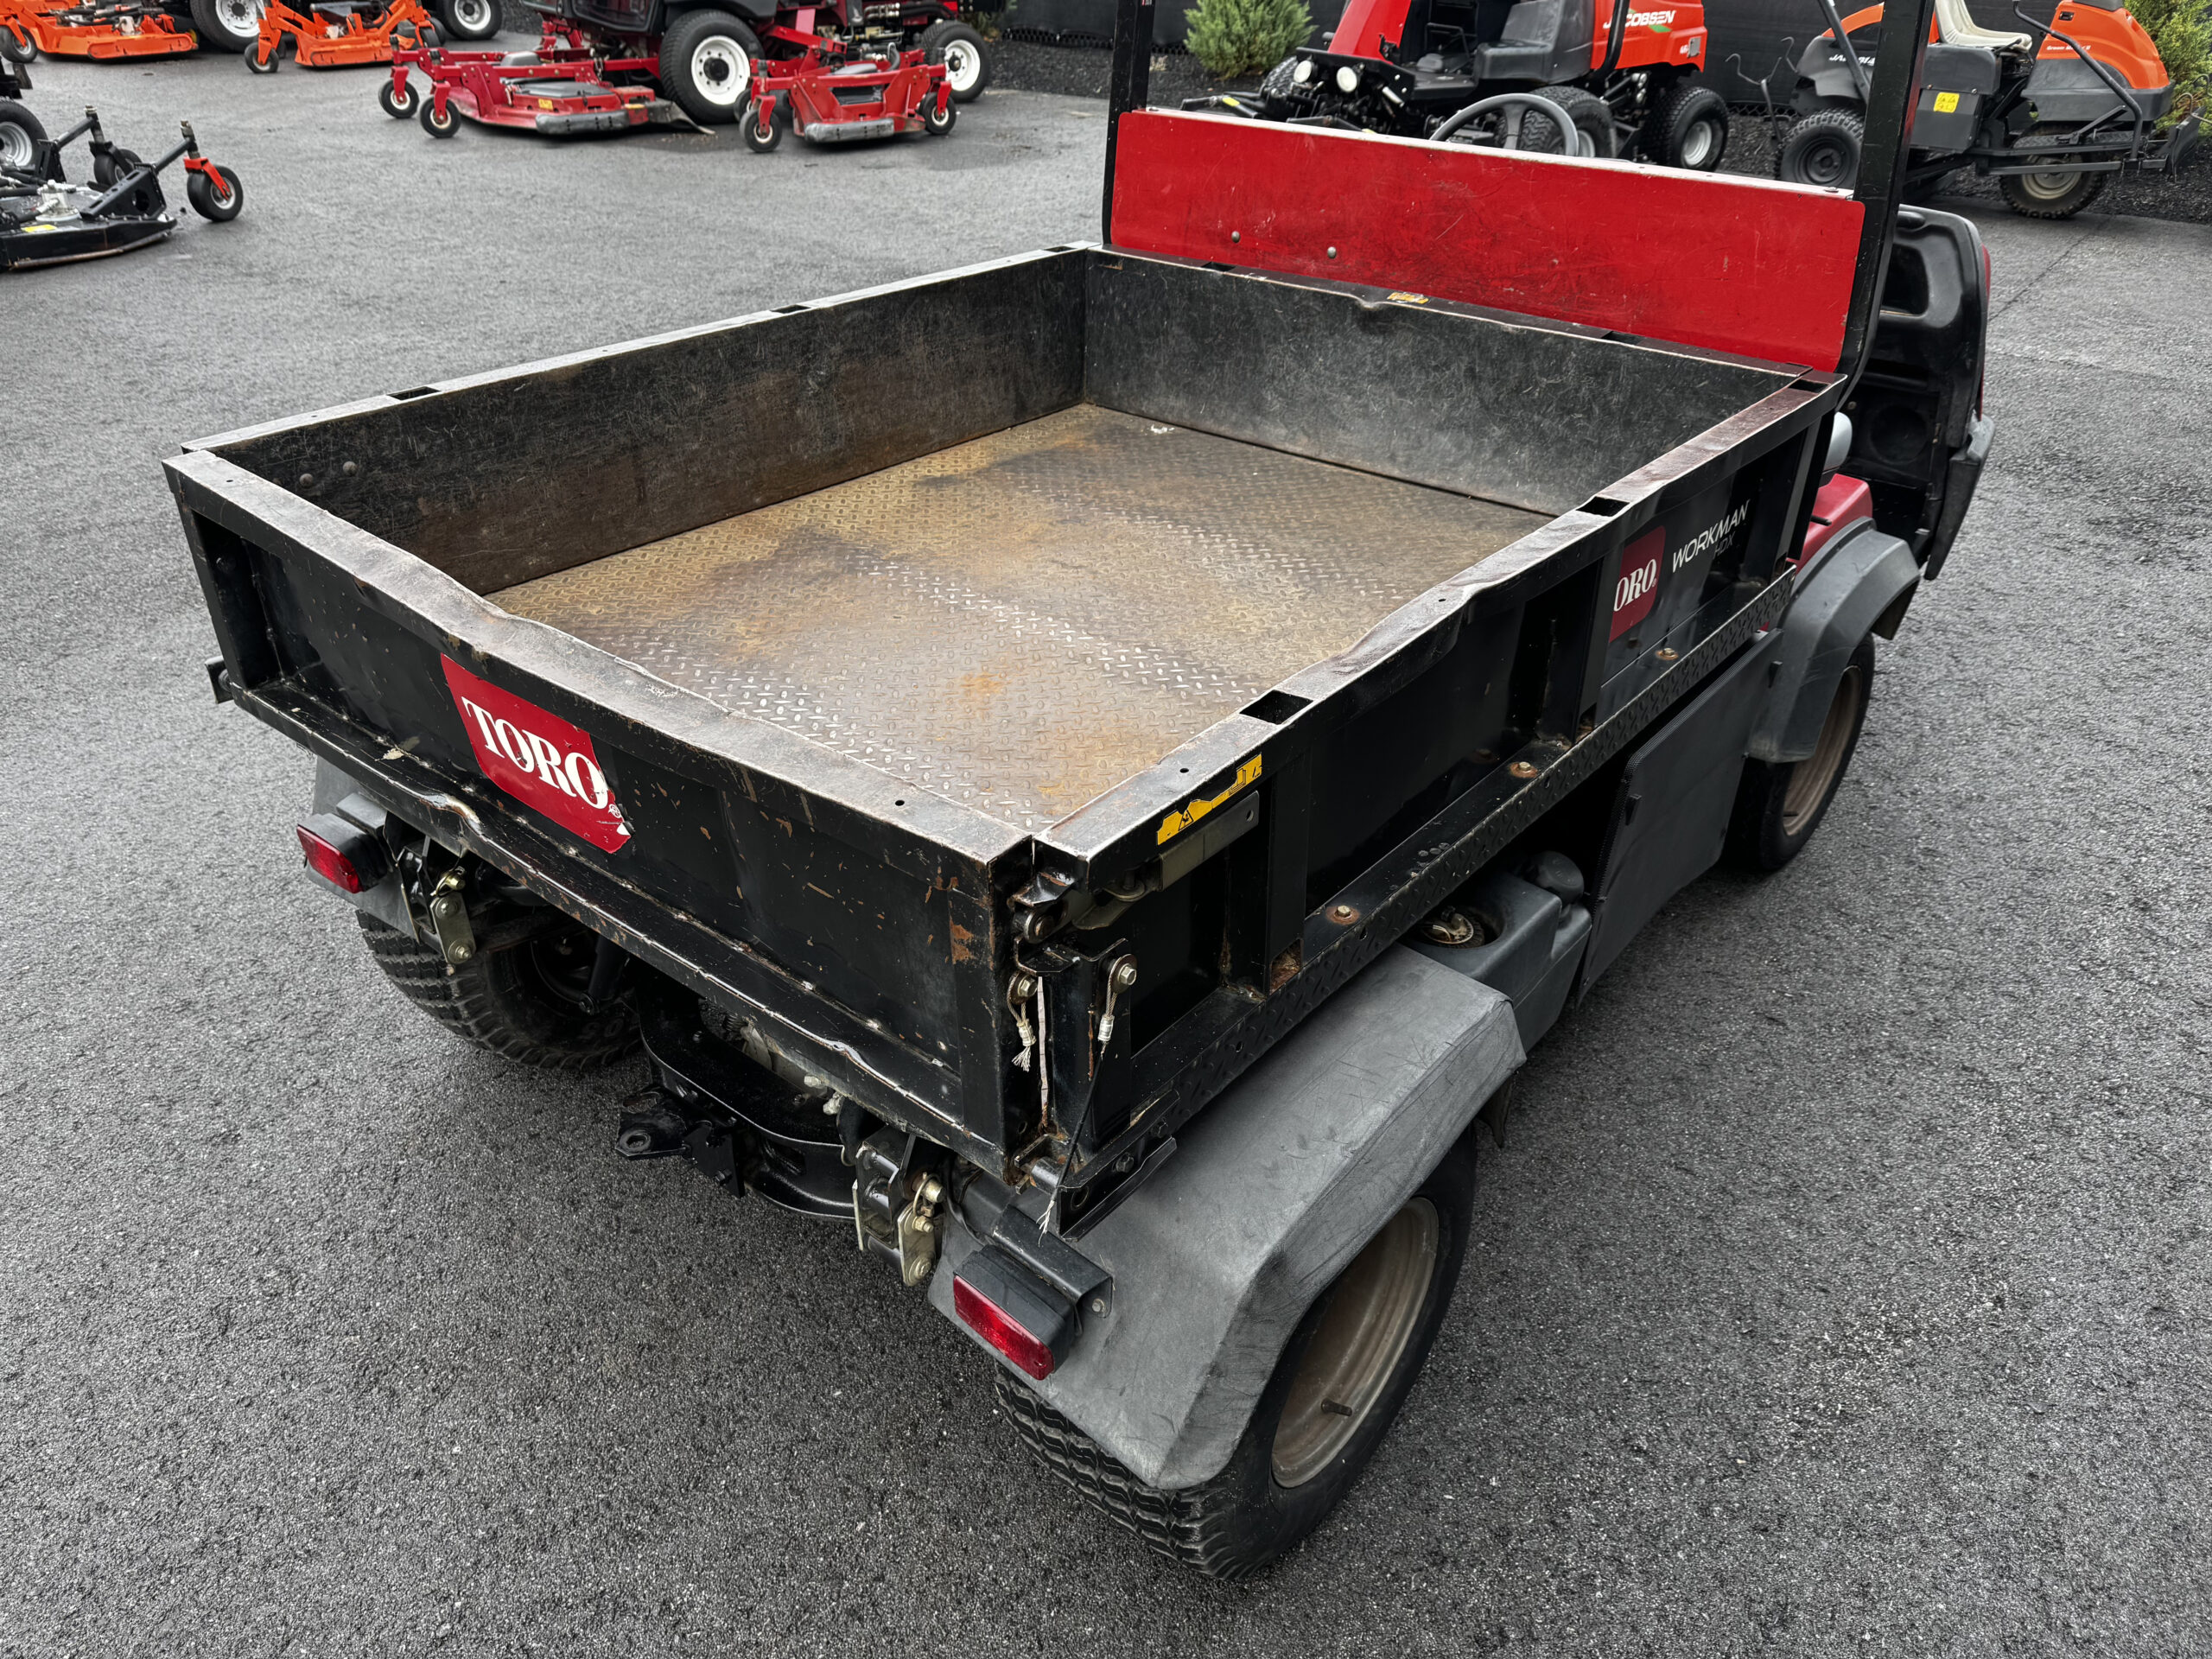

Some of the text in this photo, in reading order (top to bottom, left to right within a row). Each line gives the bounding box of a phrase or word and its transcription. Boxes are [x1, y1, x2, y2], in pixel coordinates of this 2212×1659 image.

[1602, 10, 1676, 29] JCOBSEN
[1672, 499, 1751, 573] WORKMAN
[1613, 558, 1657, 612] ORO
[461, 696, 609, 810] TORO
